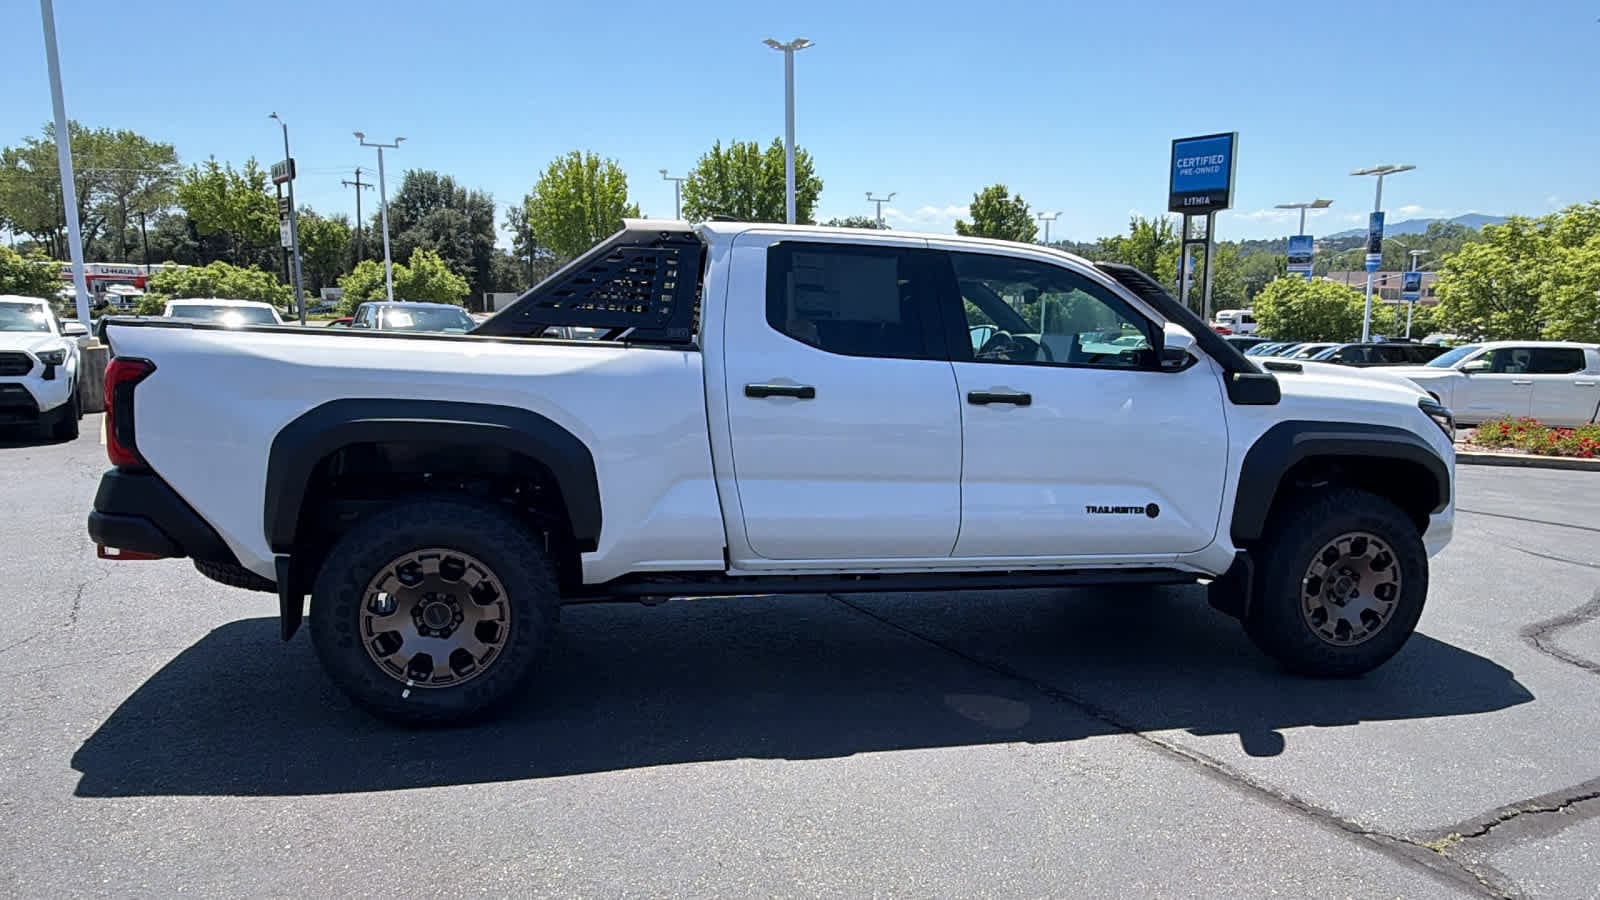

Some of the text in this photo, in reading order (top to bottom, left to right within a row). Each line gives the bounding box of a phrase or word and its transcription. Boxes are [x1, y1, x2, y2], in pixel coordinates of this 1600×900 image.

[1177, 154, 1224, 168] CERTIFIED
[1180, 165, 1220, 175] PRE-OWNED
[1184, 196, 1210, 206] LITHIA
[1085, 505, 1145, 514] TRAILHUNTER
